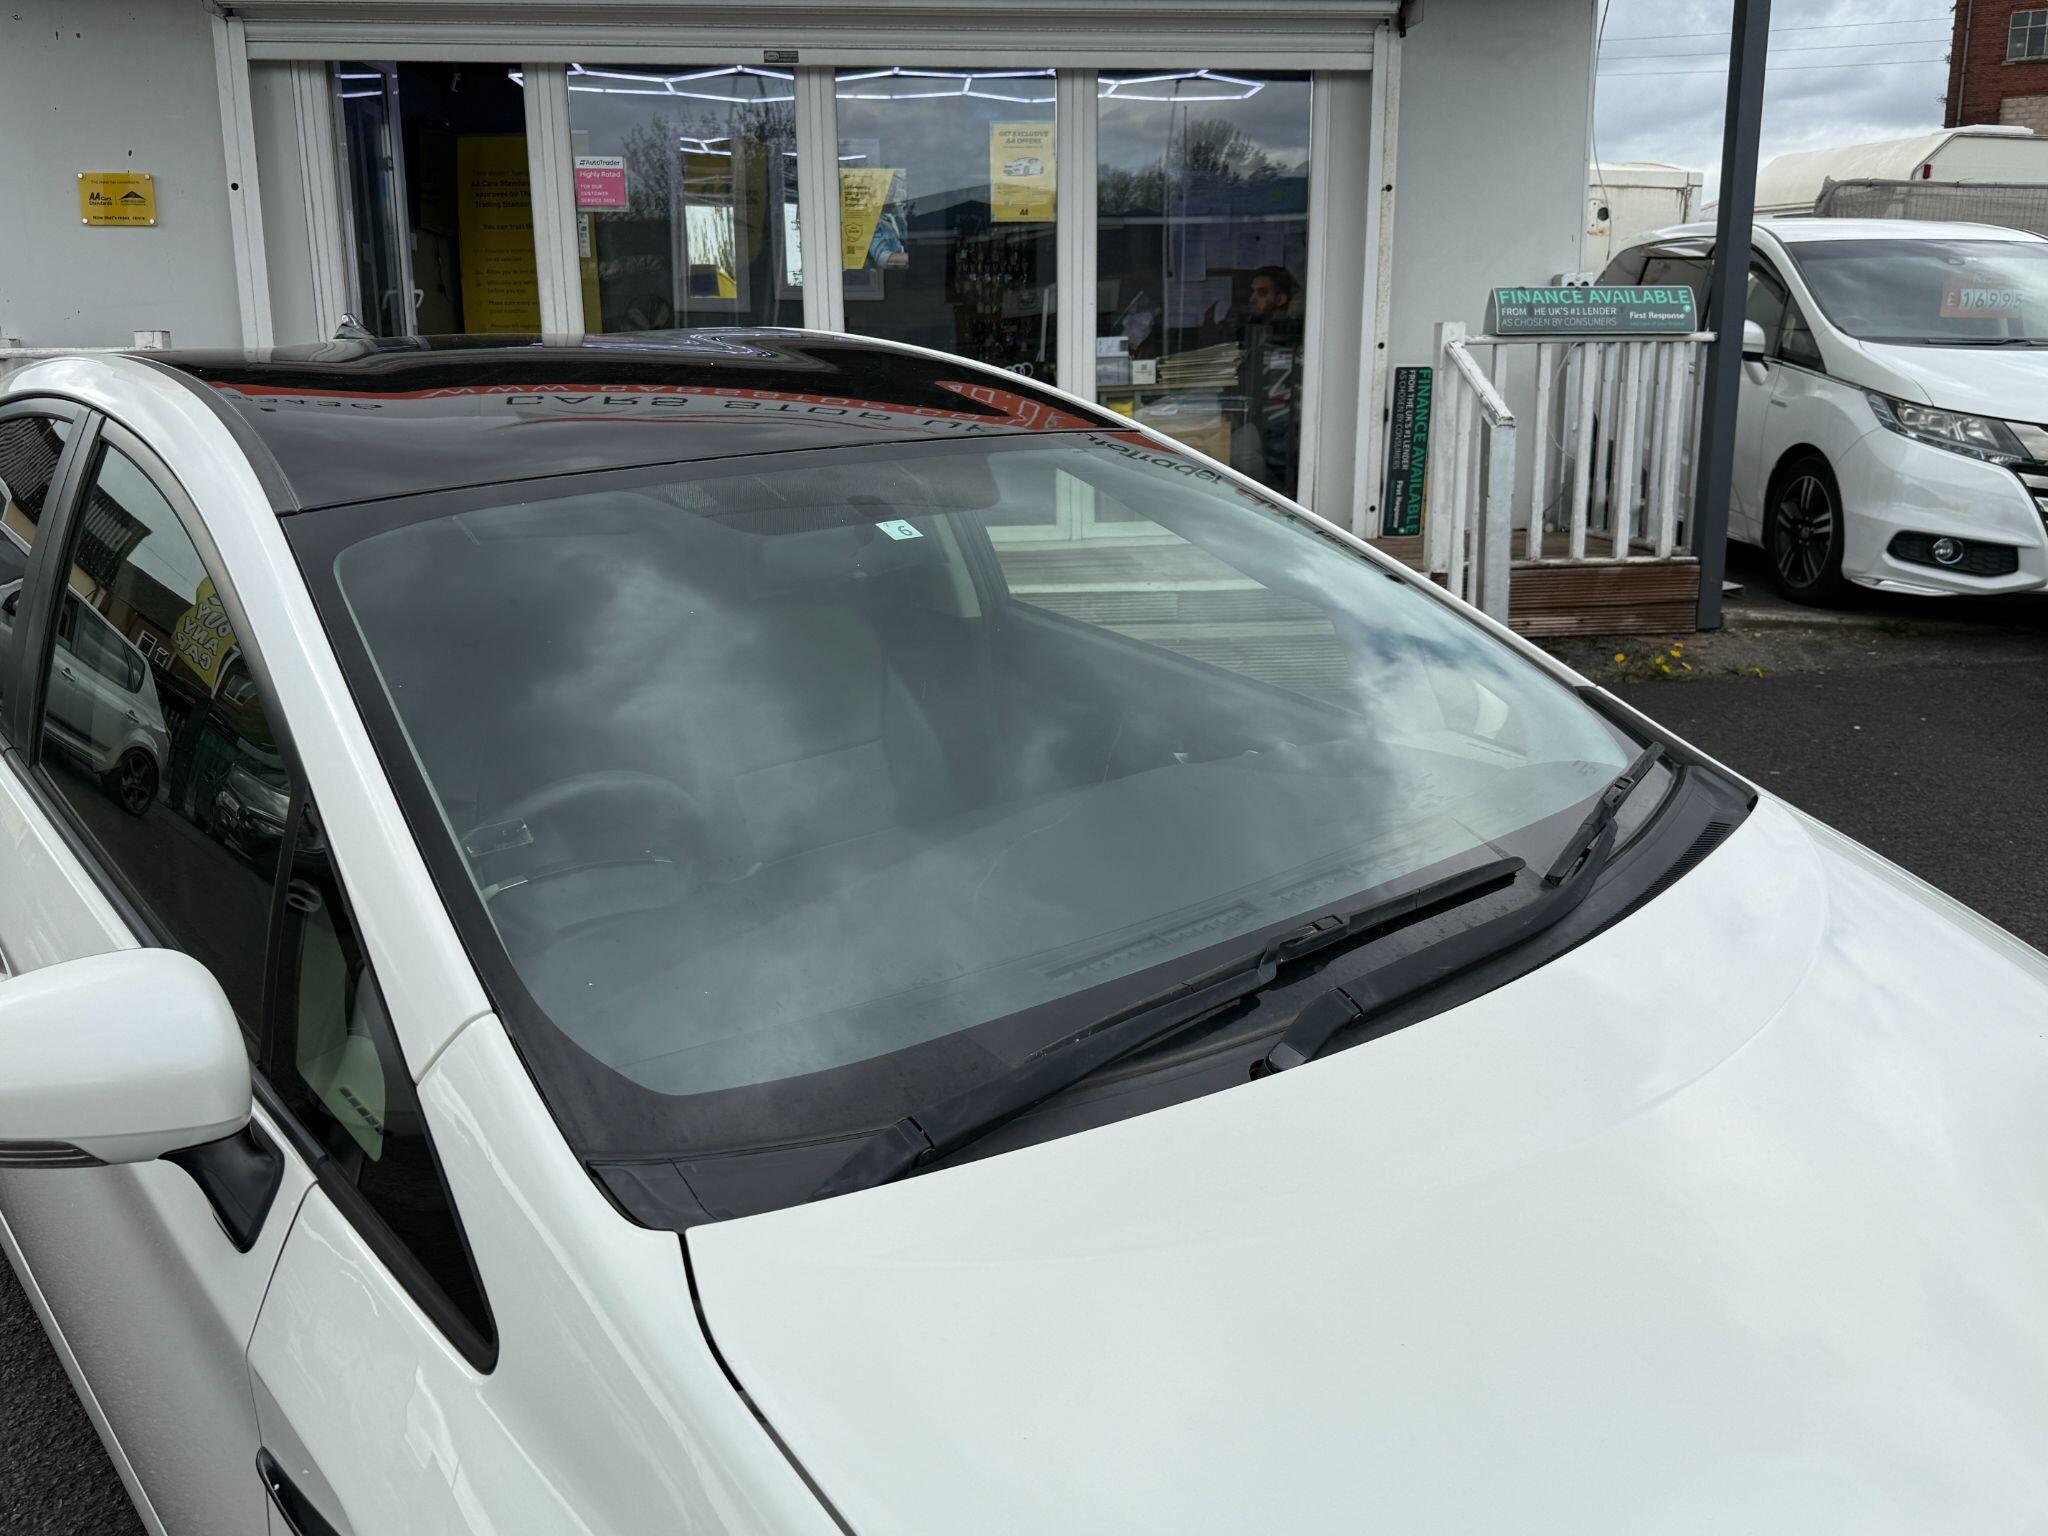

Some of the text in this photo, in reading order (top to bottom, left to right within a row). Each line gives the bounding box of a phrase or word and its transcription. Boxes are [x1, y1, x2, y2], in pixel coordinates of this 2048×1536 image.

[579, 171, 600, 179] Highly
[89, 192, 101, 200] AA
[1018, 208, 1029, 216] AA
[1498, 290, 1691, 304] FINANCE AVAILABLE
[1501, 307, 1527, 316] FROM
[1548, 307, 1569, 315] UK'S
[1570, 307, 1580, 315] #1
[1582, 307, 1617, 315] LENDER
[1648, 312, 1686, 321] Response
[1501, 318, 1617, 327] AS CHOSEN BY CONSUMERS
[1399, 370, 1406, 380] AS
[1397, 380, 1406, 412] CHOSEN
[1401, 370, 1416, 470] FROM THE UK'S #1 LENDER
[1392, 424, 1403, 470] CONSUMERS
[1406, 369, 1432, 534] FINANCE AVAILABLE
[1392, 480, 1404, 529] First Response
